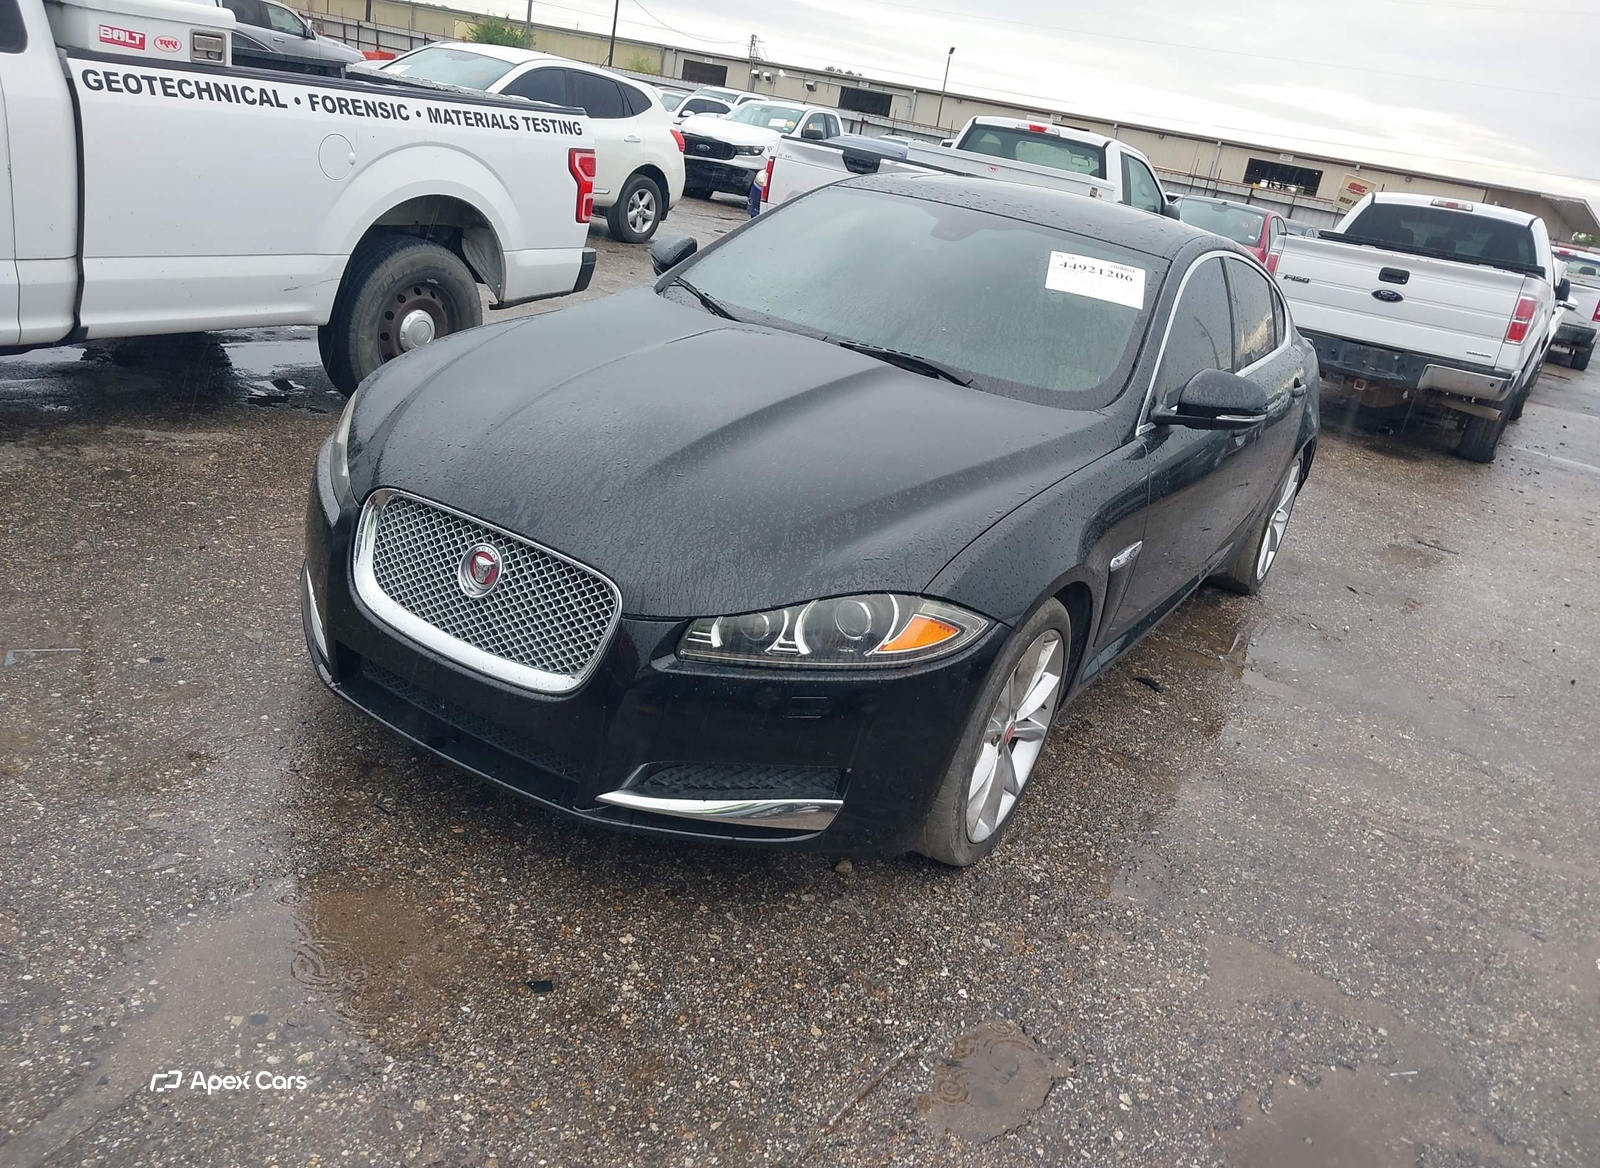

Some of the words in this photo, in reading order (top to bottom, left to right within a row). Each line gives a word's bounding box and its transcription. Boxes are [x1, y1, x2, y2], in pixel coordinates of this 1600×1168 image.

[100, 26, 144, 45] BOLT
[81, 68, 288, 109] GEOTECHNICAL
[308, 93, 410, 122] FORENSIC
[427, 106, 519, 132] MATERIALS
[522, 115, 583, 137] TESTING
[1059, 261, 1133, 282] 44921206
